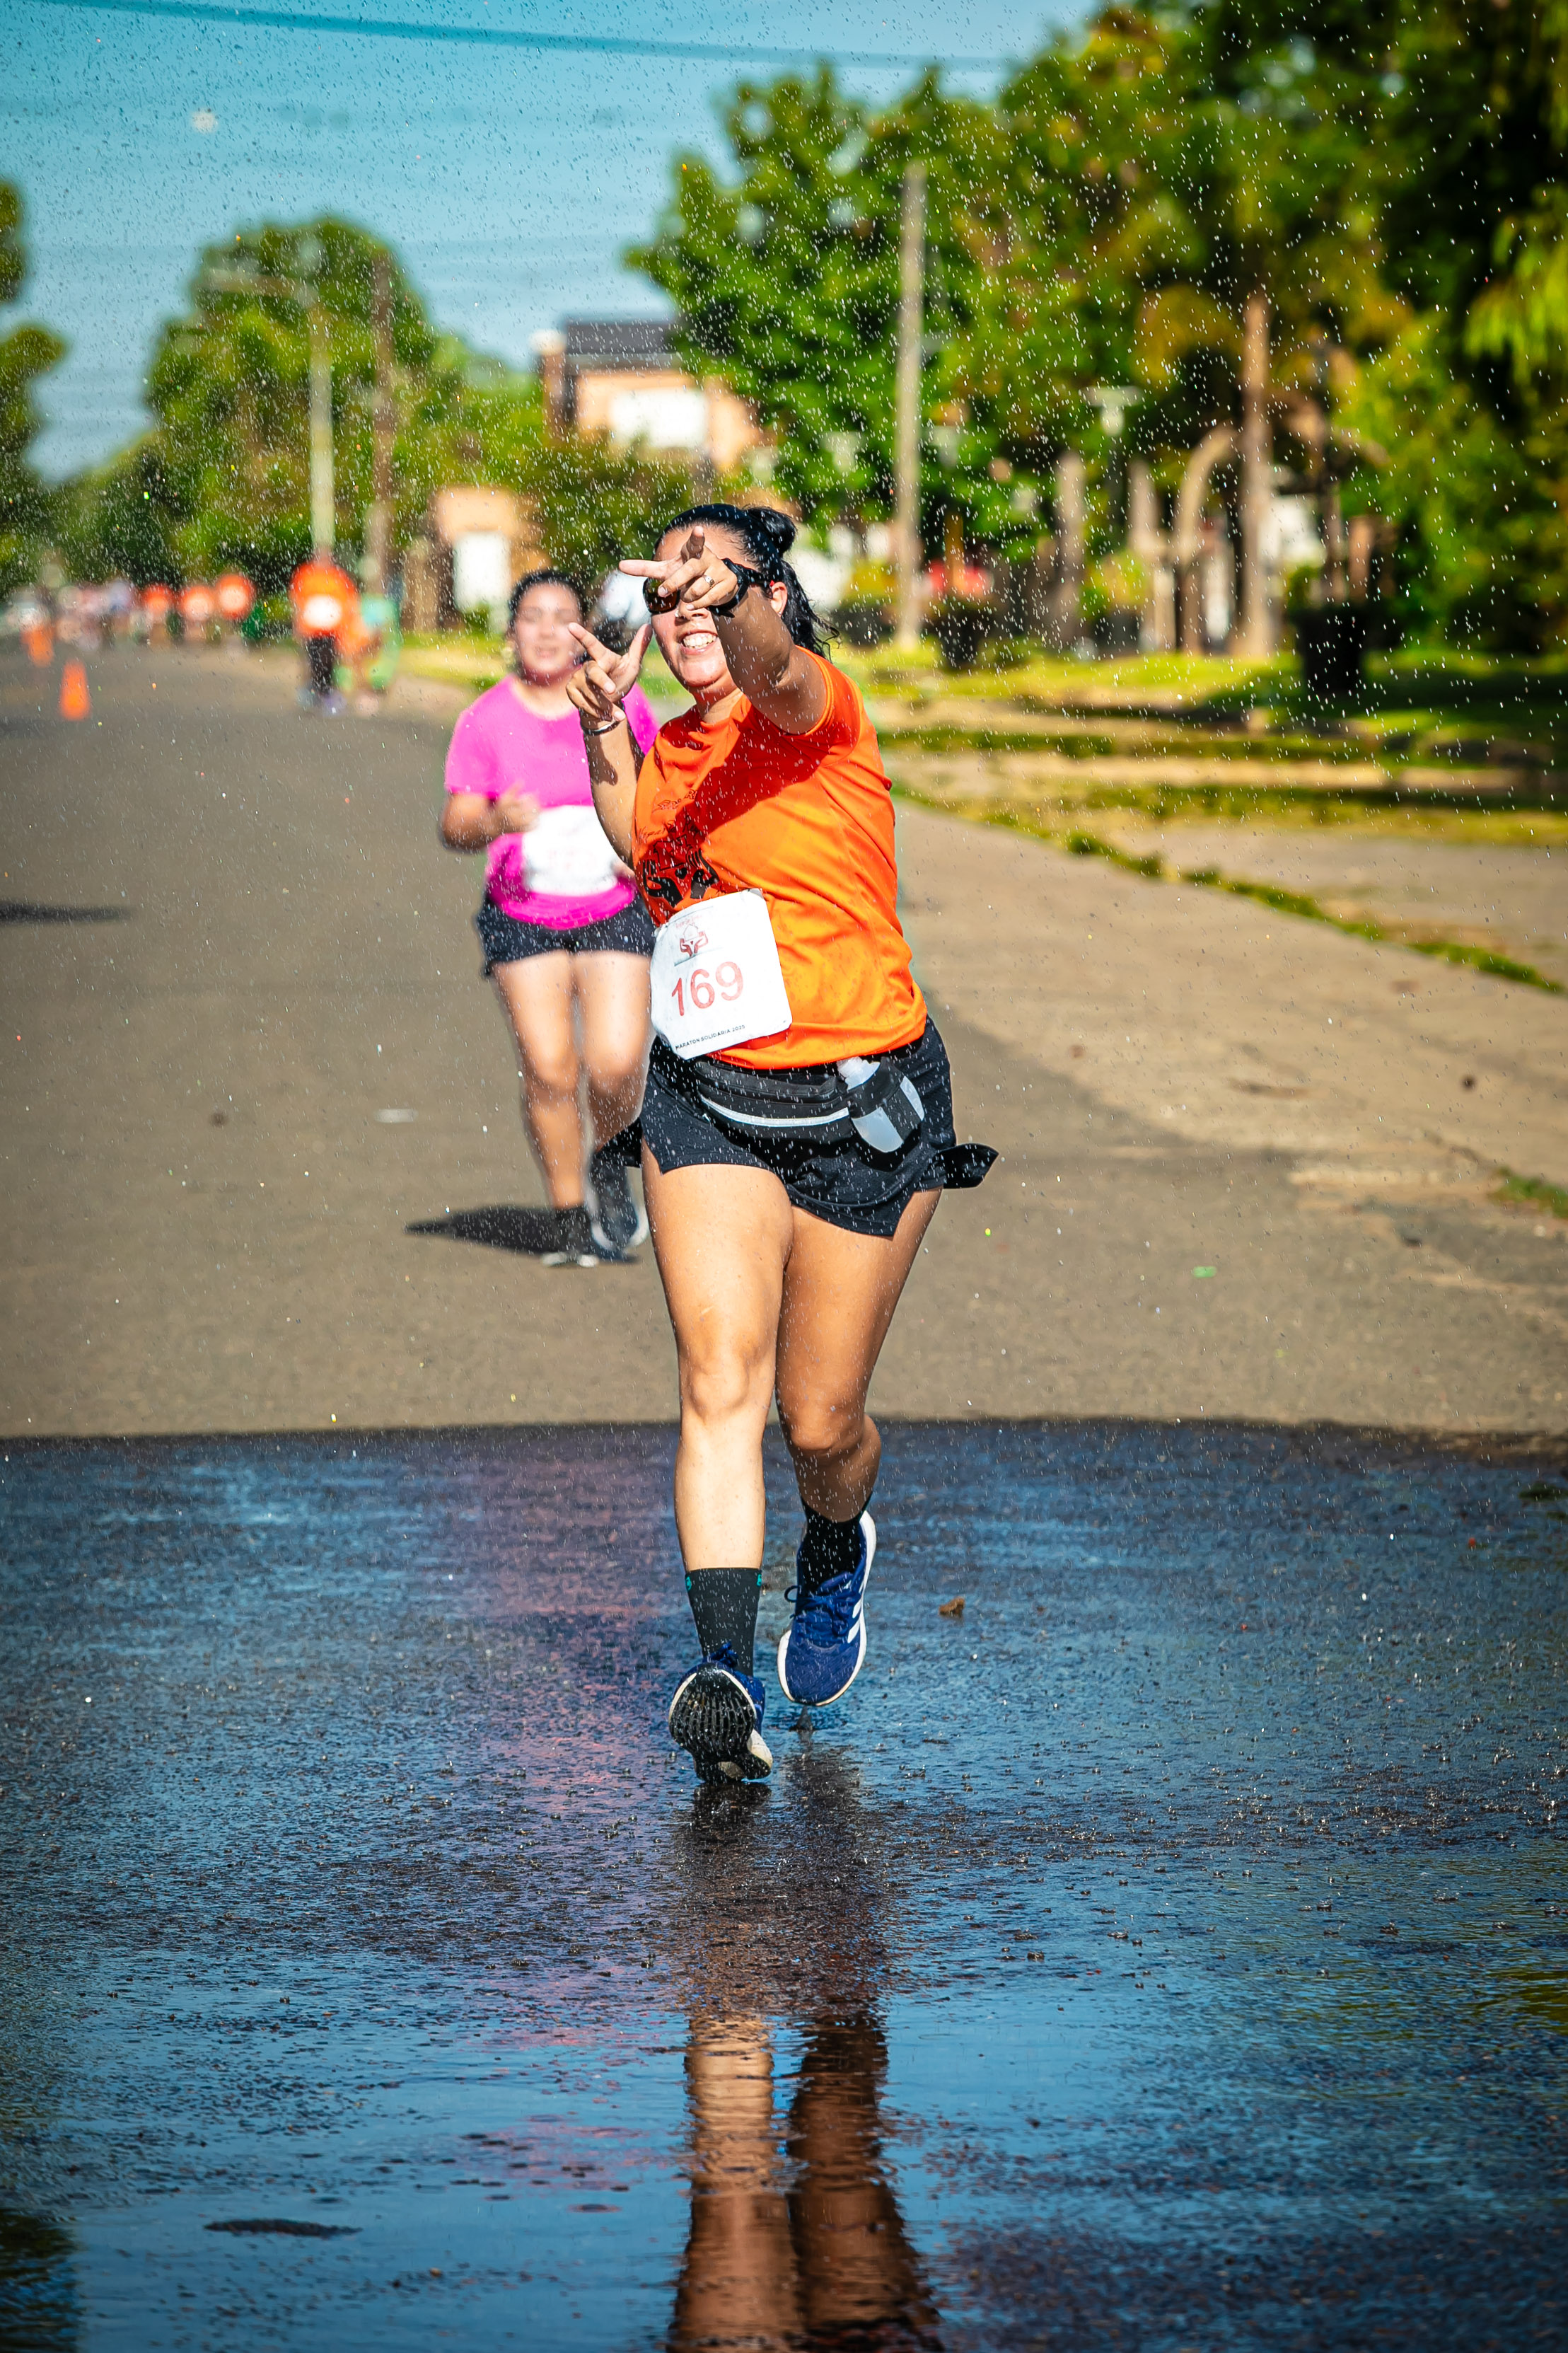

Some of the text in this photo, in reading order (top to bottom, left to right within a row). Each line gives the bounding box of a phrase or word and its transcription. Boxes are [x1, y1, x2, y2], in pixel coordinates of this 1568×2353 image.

[671, 961, 744, 1017] 169
[675, 1038, 700, 1049] MARATON
[700, 1029, 731, 1041] SOLIDARIA
